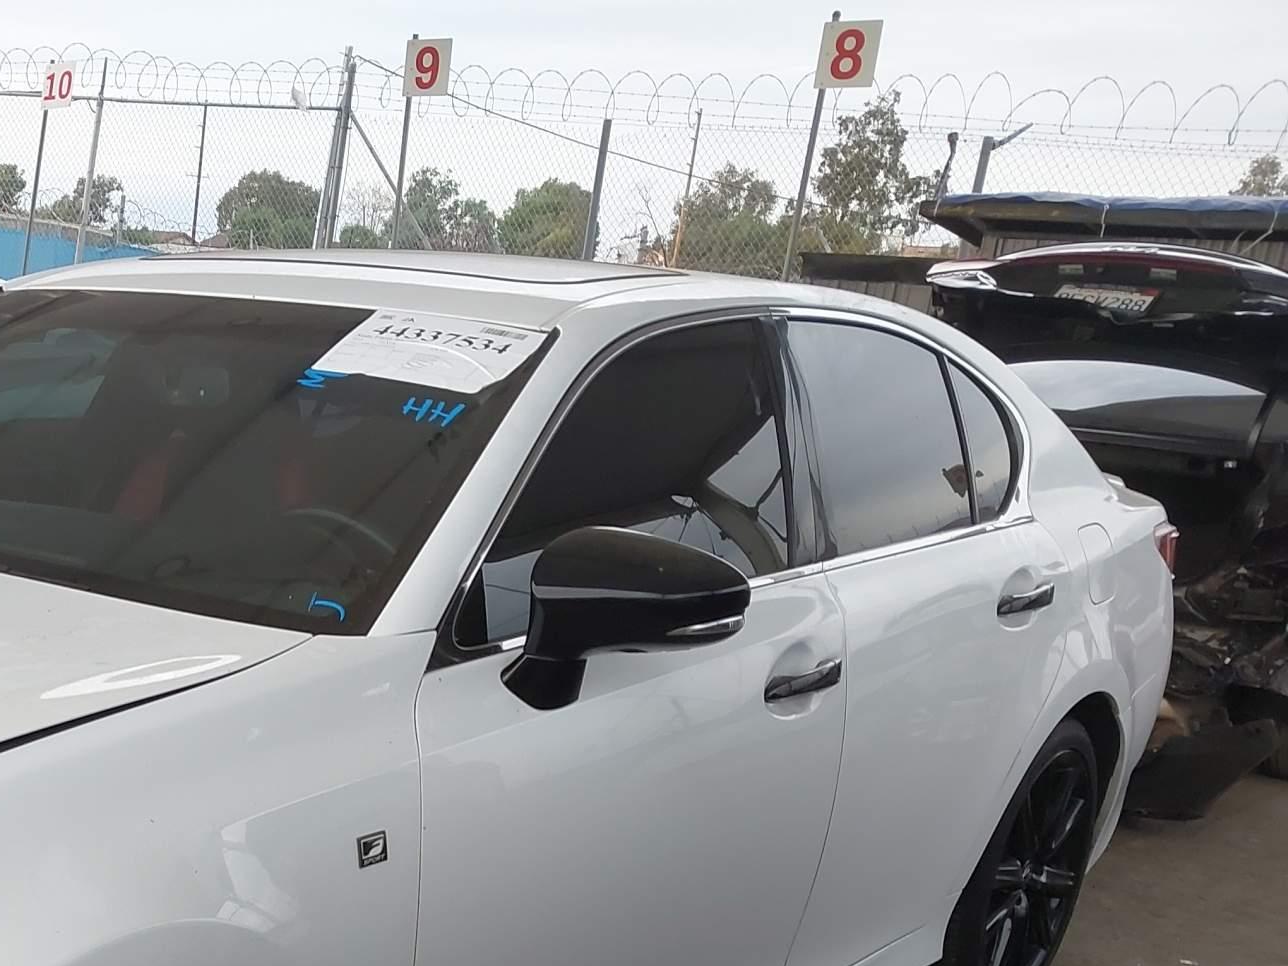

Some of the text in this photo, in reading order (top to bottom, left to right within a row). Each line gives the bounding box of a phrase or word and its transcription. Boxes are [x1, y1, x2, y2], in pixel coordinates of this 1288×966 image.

[415, 46, 440, 90] 9
[830, 29, 865, 80] 8
[44, 71, 73, 100] 10
[373, 325, 512, 354] 44337534
[402, 397, 466, 428] HH
